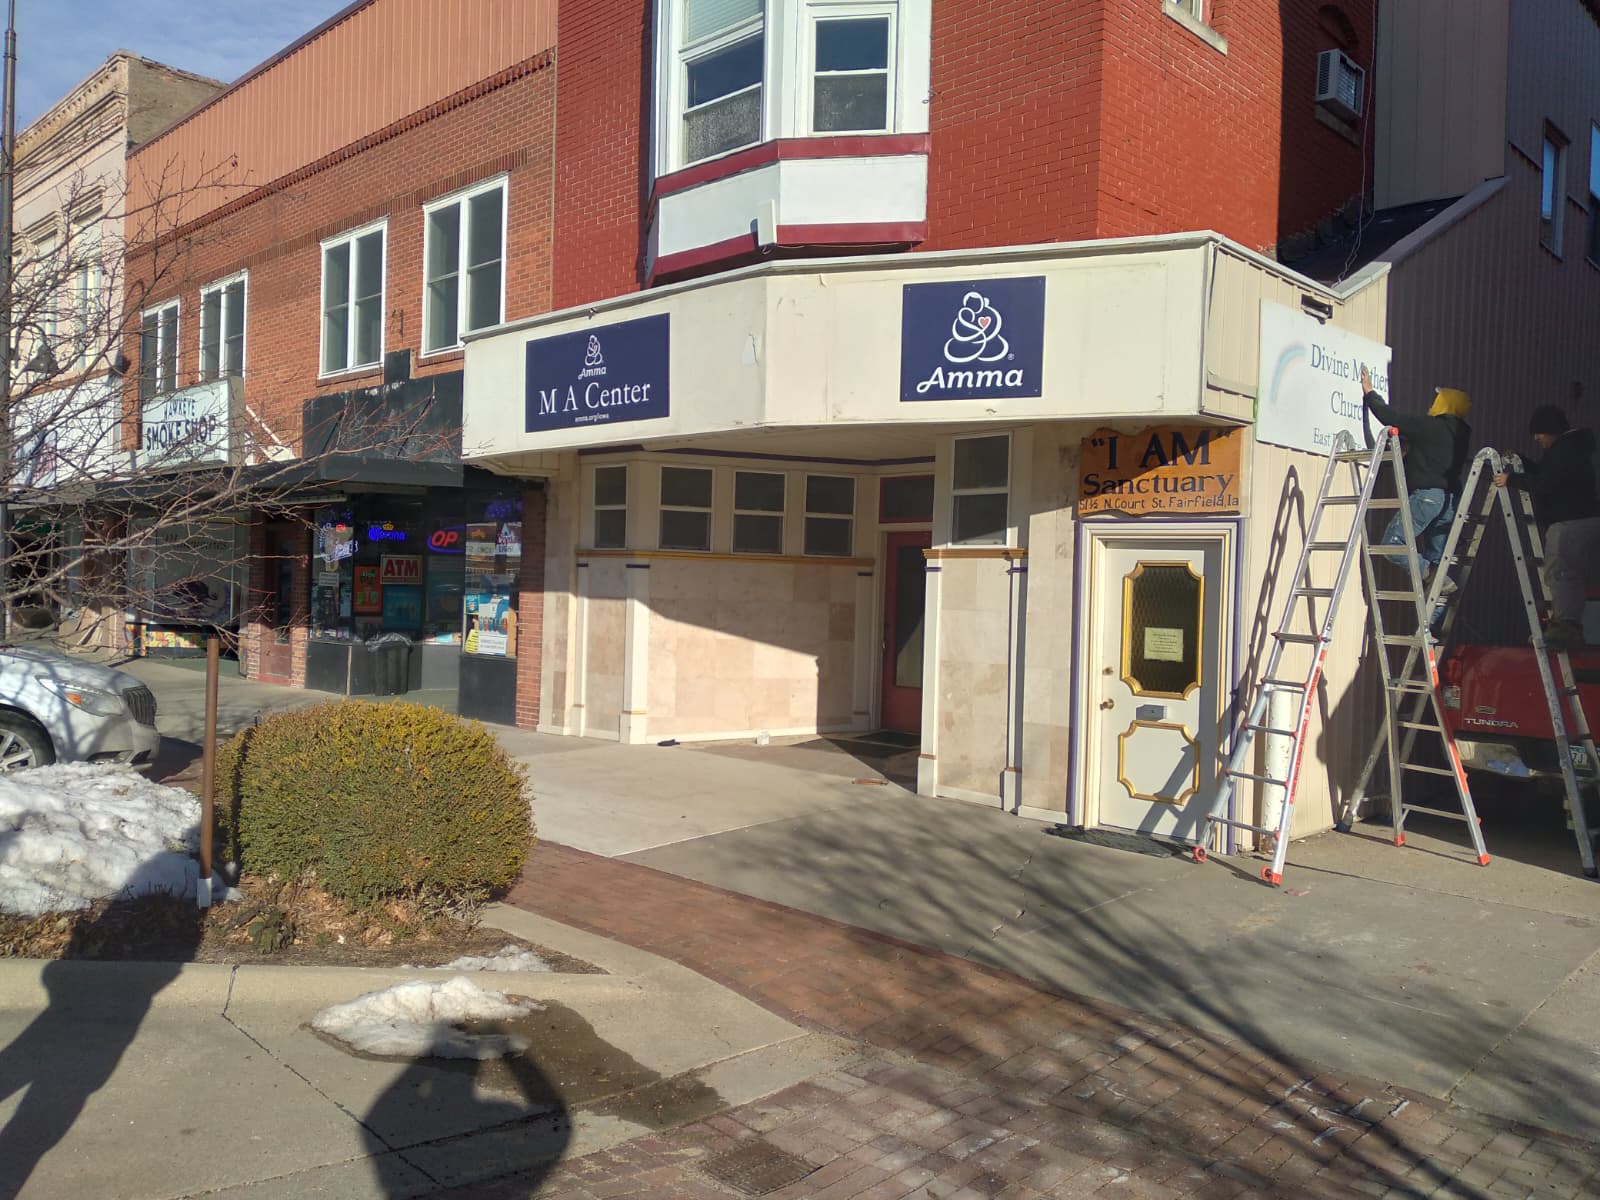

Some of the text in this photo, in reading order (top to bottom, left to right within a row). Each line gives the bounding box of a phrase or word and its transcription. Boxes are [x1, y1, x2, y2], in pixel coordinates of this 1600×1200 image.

[577, 366, 607, 380] Amma
[916, 366, 1024, 393] Amma
[1311, 344, 1389, 393] Divine Mther
[538, 382, 651, 415] M A Center
[1331, 391, 1364, 421] Churc
[146, 414, 216, 451] SMOKE SHOP
[1313, 427, 1331, 447] East
[1083, 473, 1234, 497] Sanctuary
[431, 530, 459, 547] OP
[383, 558, 419, 577] ATM
[1464, 717, 1519, 728] TUNDRA
